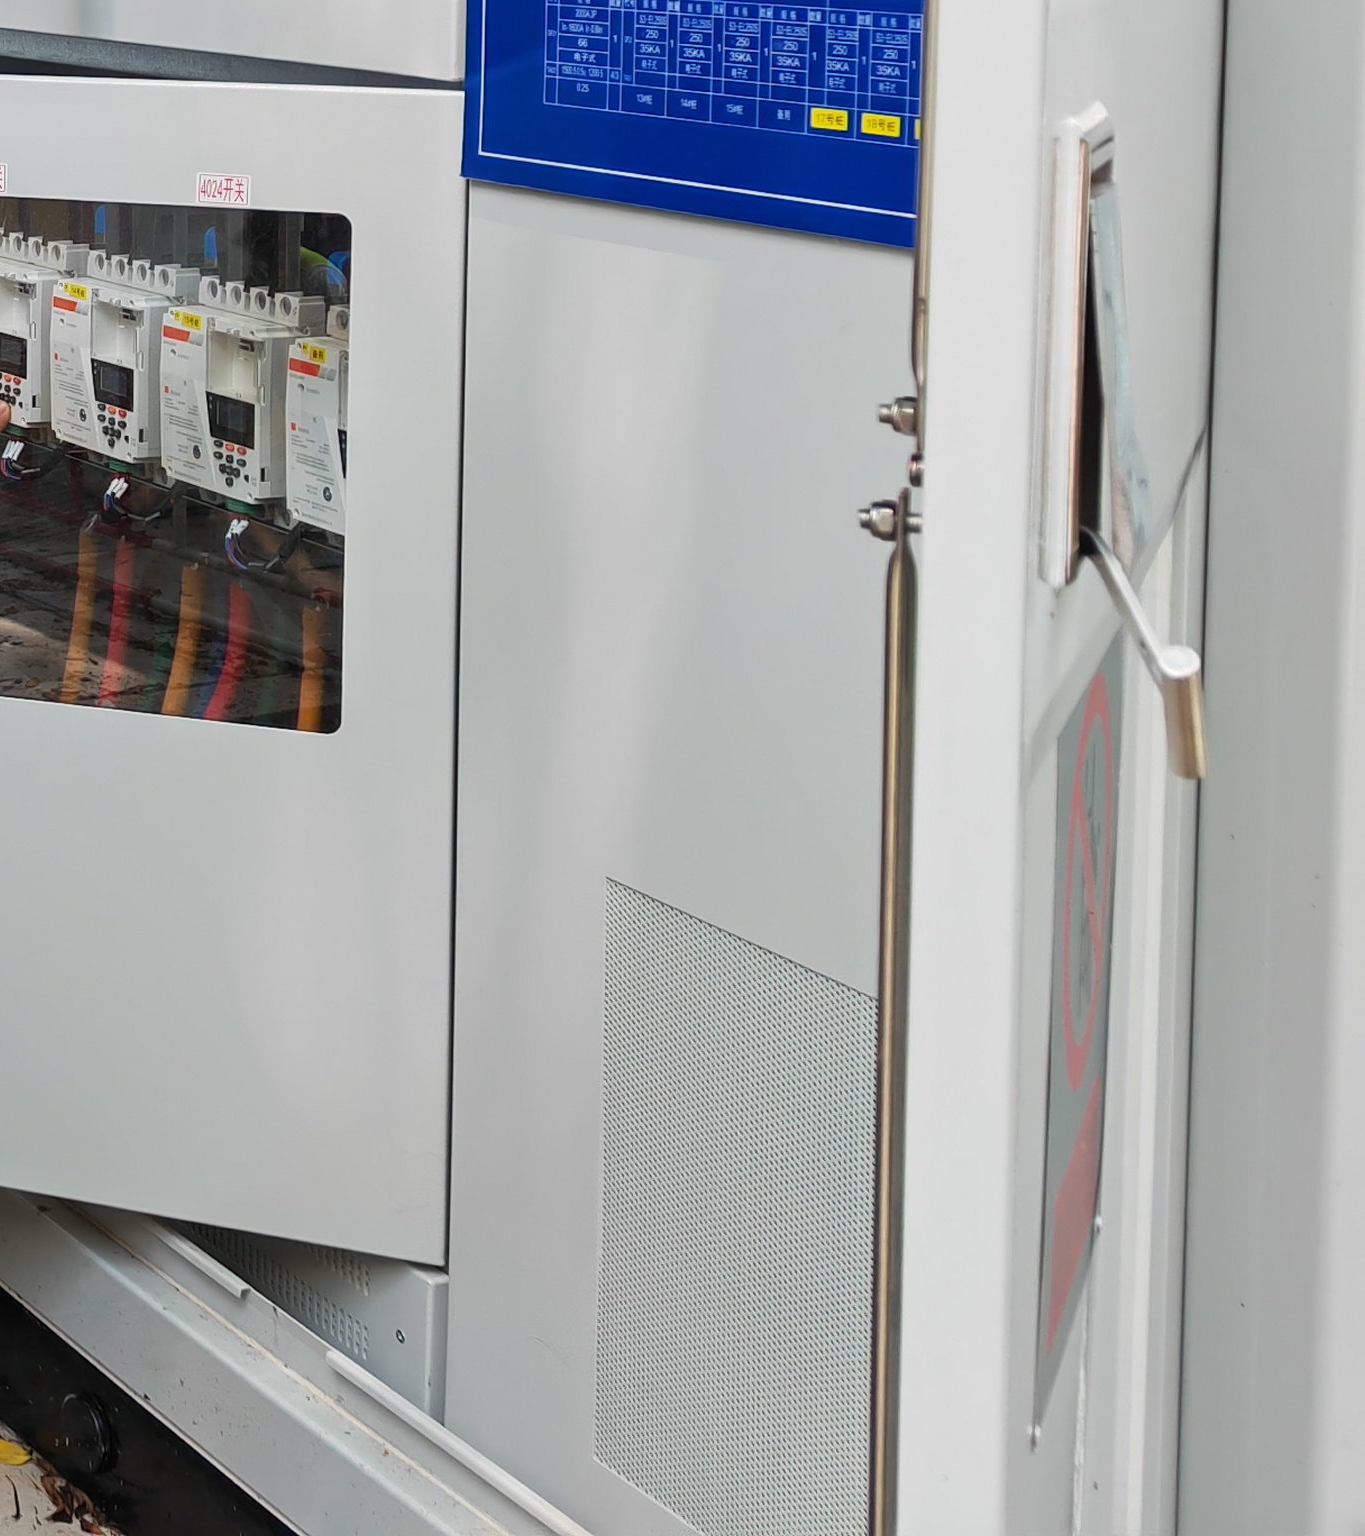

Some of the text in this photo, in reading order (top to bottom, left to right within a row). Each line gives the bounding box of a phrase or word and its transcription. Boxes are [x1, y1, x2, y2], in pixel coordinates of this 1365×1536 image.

[646, 29, 659, 39] 250
[689, 33, 703, 43] 250
[735, 37, 750, 47] 250
[783, 40, 798, 52] 250
[832, 44, 848, 56] 250
[883, 49, 898, 60] 250
[200, 178, 244, 202] 4024开关
